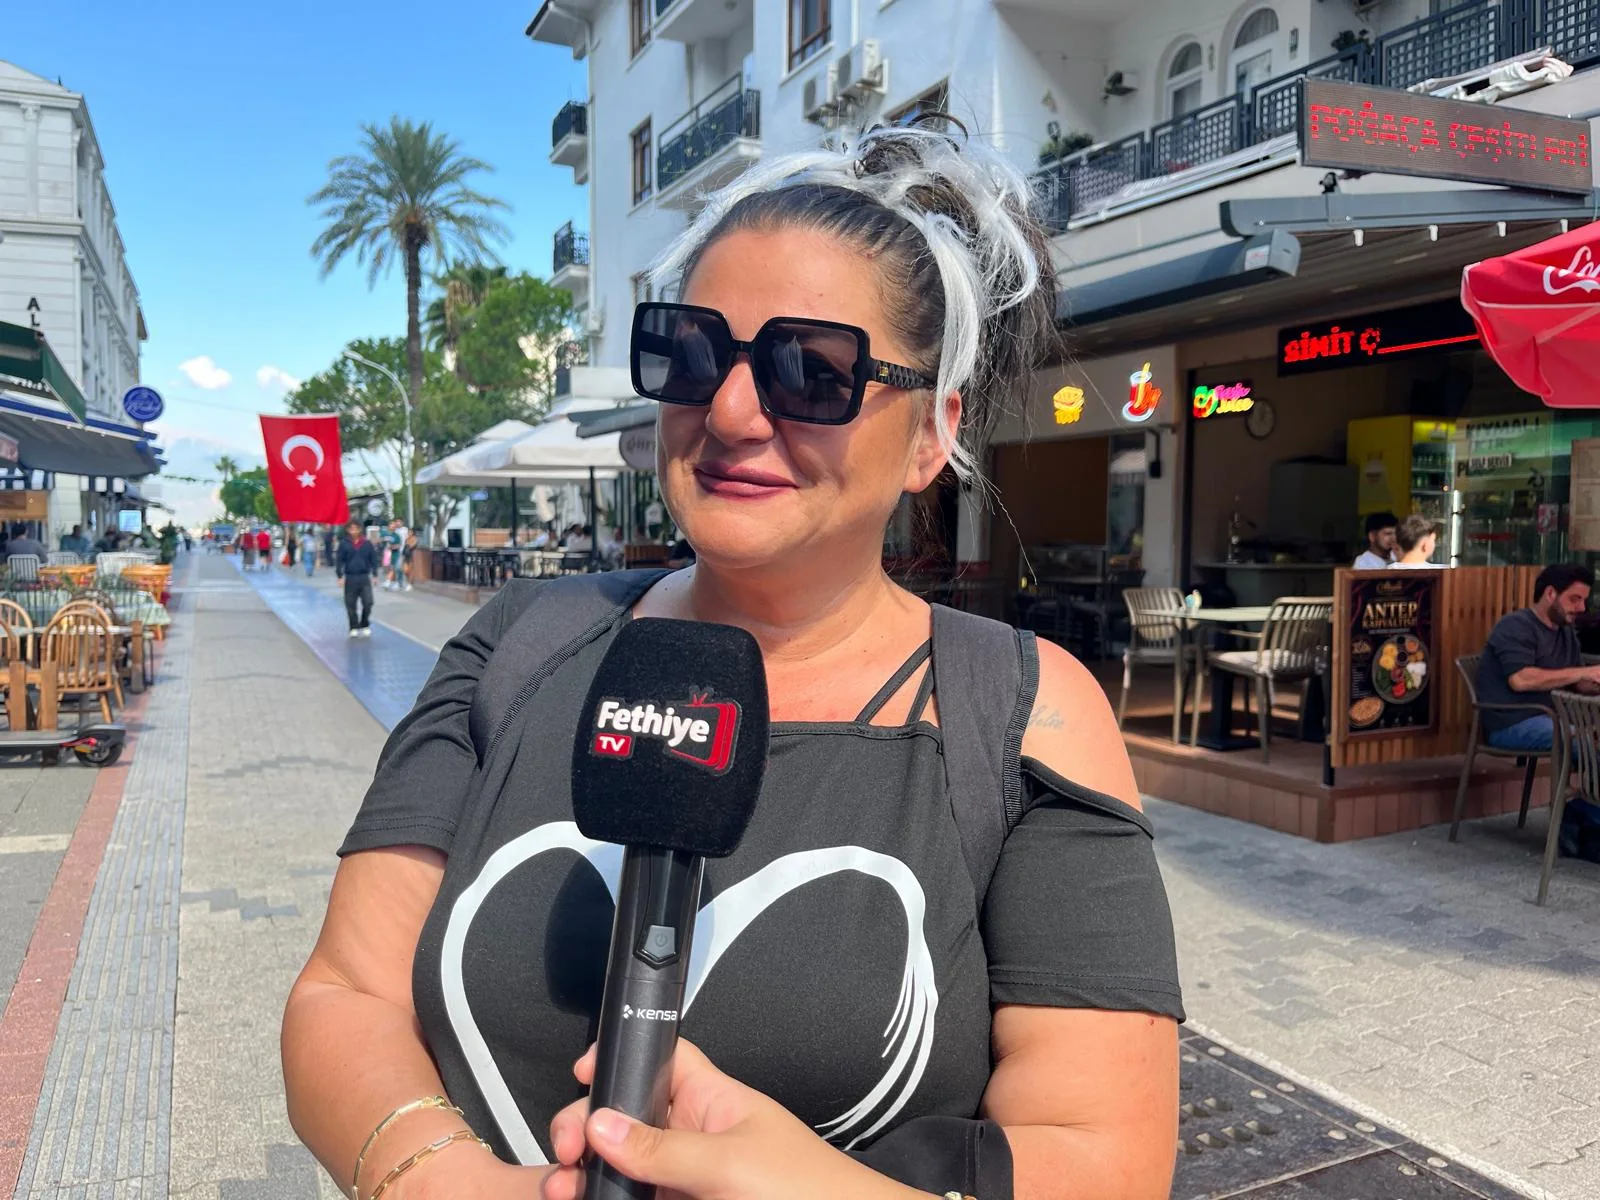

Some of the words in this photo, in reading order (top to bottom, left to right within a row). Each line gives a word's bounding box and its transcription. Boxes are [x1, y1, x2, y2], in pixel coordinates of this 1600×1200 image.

[1363, 602, 1418, 619] ANTEP
[597, 701, 710, 747] Fethiye
[599, 735, 626, 752] TV
